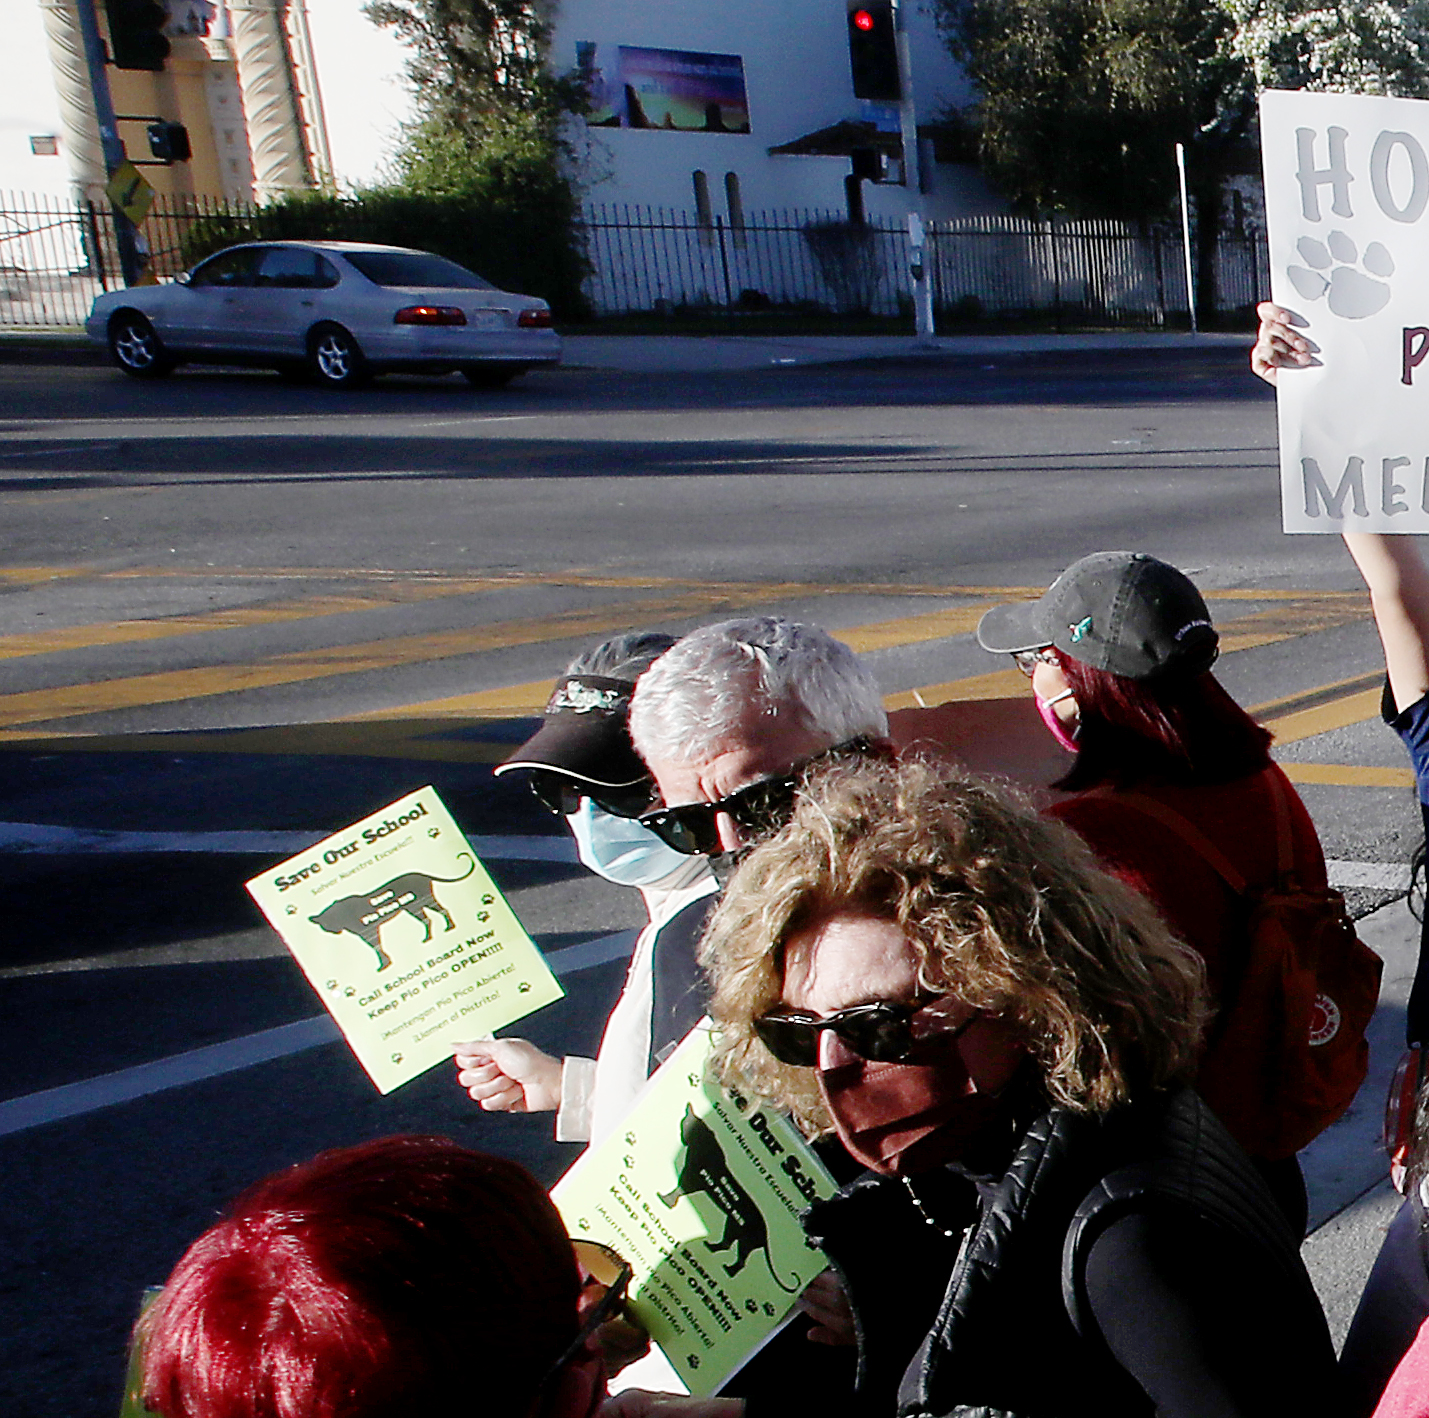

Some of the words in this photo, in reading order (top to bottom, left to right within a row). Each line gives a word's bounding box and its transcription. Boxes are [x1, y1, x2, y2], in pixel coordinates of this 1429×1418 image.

[275, 863, 321, 892] Save
[324, 842, 359, 865] Our
[362, 803, 428, 844] School
[359, 989, 382, 1006] Call
[385, 966, 424, 991] School
[428, 944, 463, 968] Board
[467, 930, 495, 948] Now
[368, 1000, 398, 1019] Keep
[401, 988, 419, 1001] Pio
[422, 972, 448, 988] Pico
[749, 1112, 785, 1156] Our
[619, 1173, 641, 1200] Call
[642, 1202, 681, 1249] School
[680, 1248, 717, 1290] Board
[716, 1289, 743, 1322] Now
